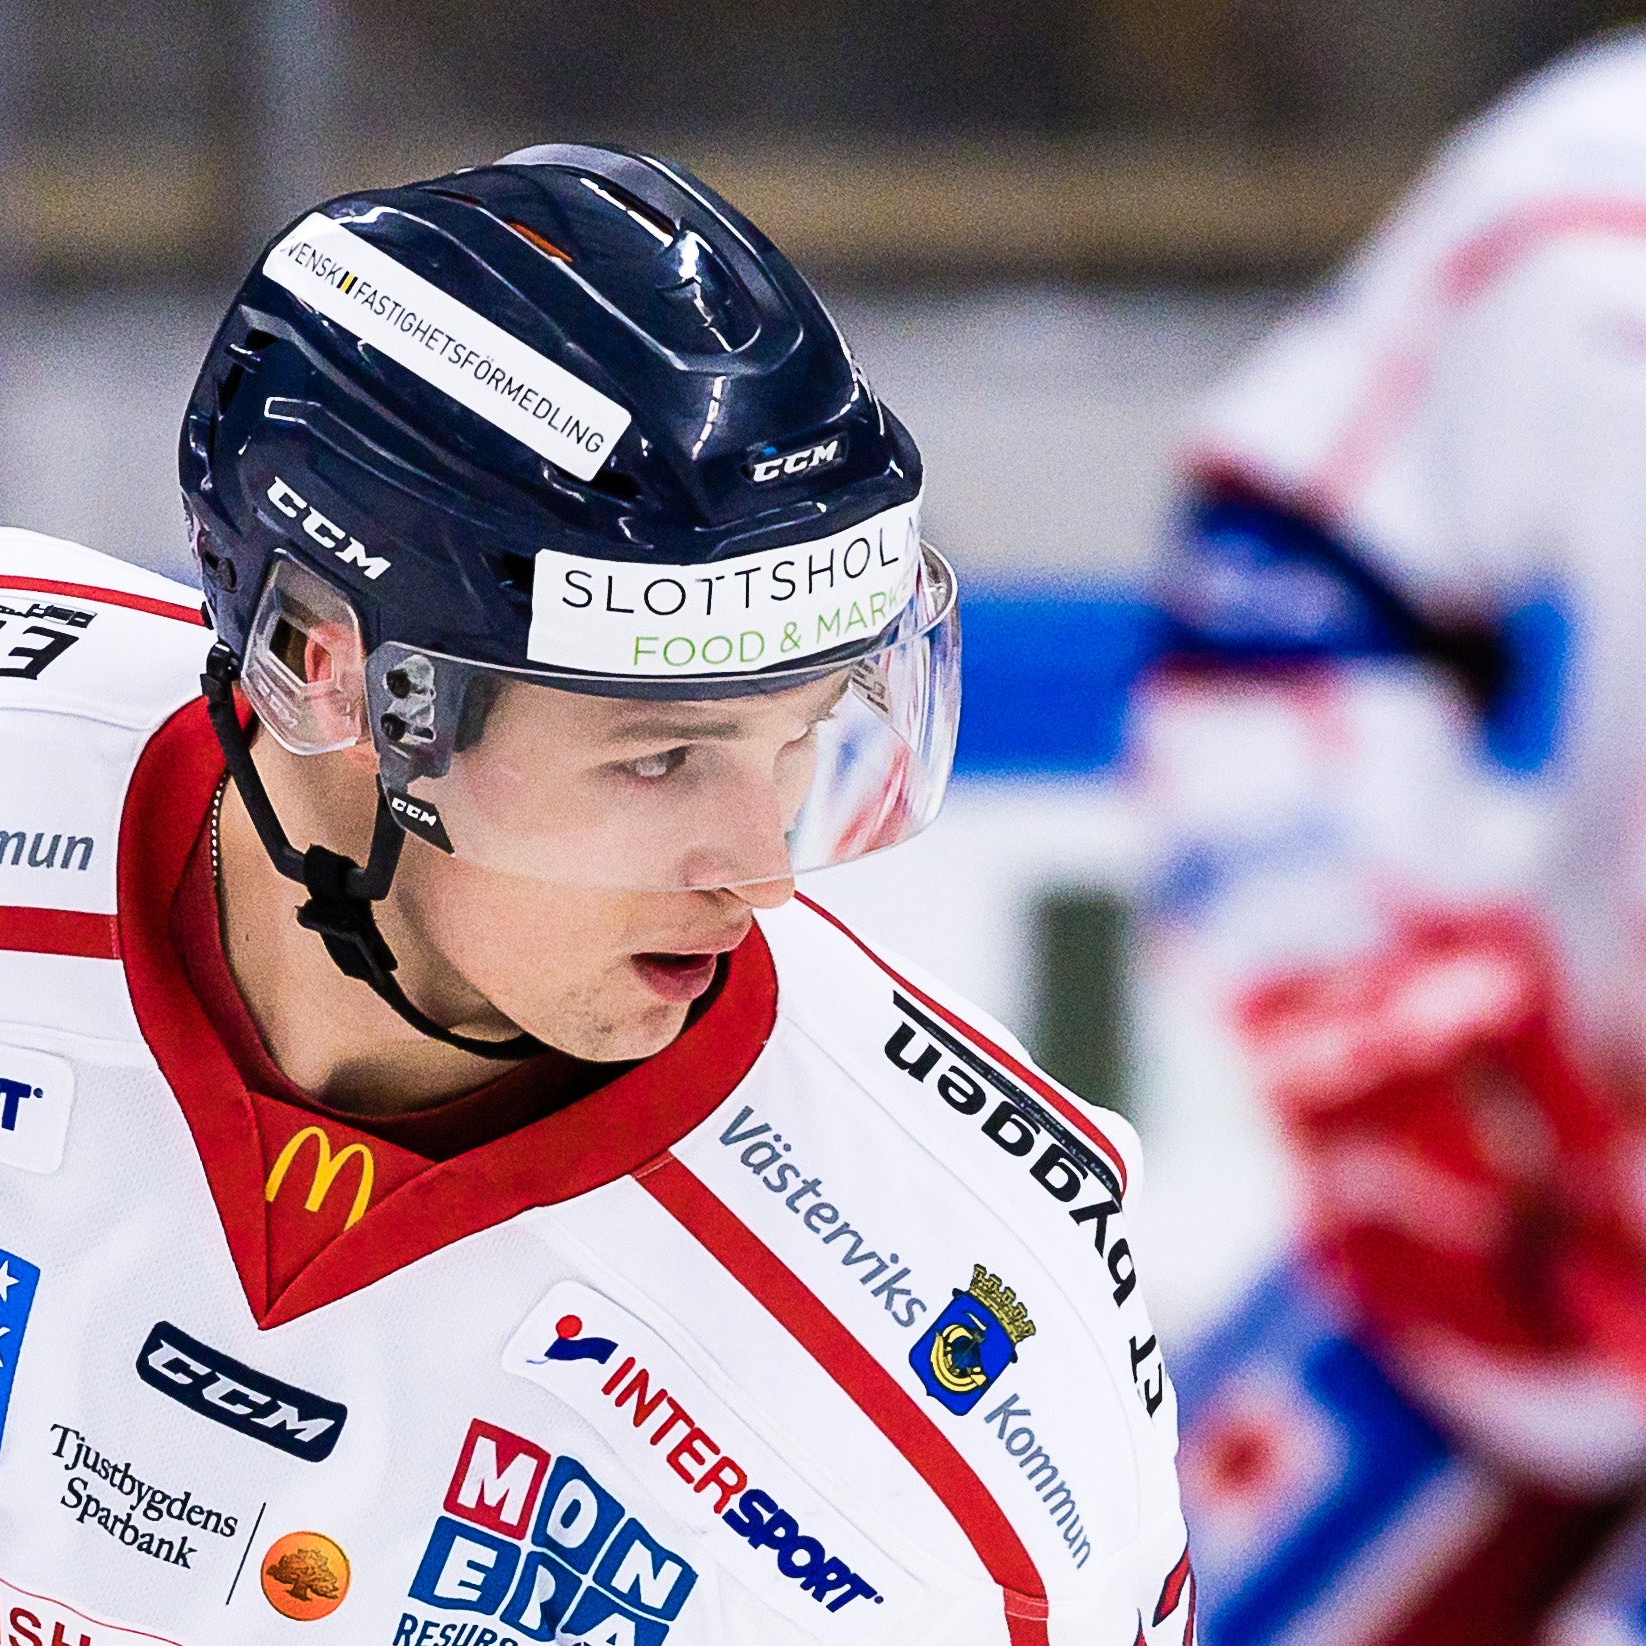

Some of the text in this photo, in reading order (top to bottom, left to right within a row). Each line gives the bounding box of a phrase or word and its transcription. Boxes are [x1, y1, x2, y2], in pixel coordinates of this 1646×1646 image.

[280, 238, 606, 455] VENSK FASTIGHETSFÖRMEDLING
[753, 440, 840, 483] CCM
[266, 476, 392, 581] CCM
[562, 516, 915, 617] SLOTTSHOL
[633, 629, 765, 668] FOOD
[779, 622, 801, 654] &
[391, 796, 437, 827] CCM
[883, 1020, 1139, 1309] byggen
[718, 1104, 1092, 1571] Västerviks Kommun
[147, 1338, 336, 1443] CCM
[50, 1423, 239, 1538] Tjustbygdens
[60, 1476, 198, 1570] Sparbank
[600, 1356, 879, 1613] INTERSPORT
